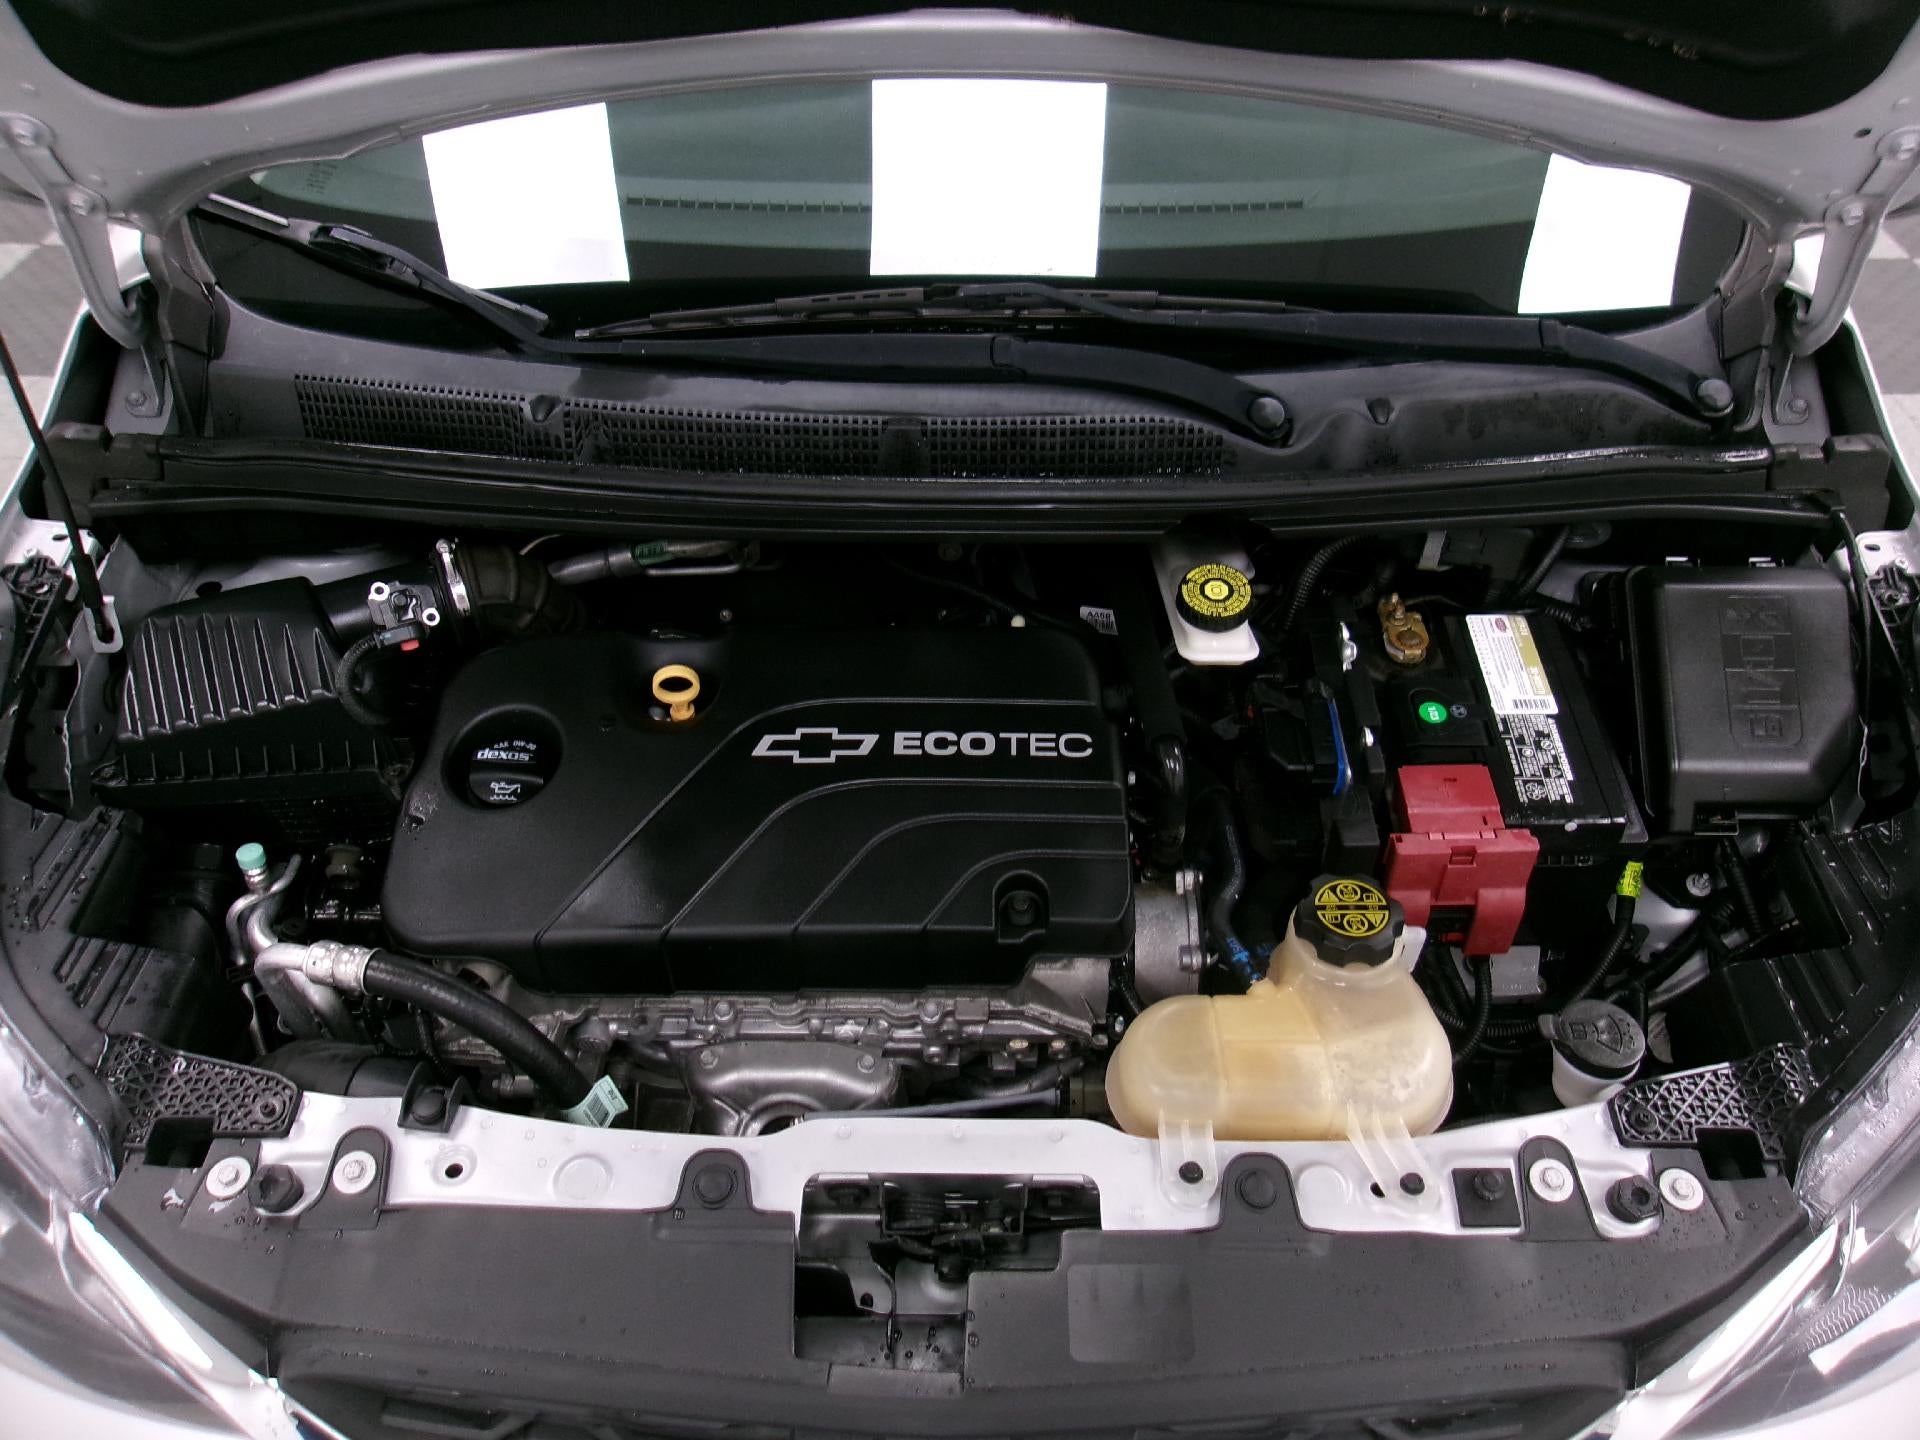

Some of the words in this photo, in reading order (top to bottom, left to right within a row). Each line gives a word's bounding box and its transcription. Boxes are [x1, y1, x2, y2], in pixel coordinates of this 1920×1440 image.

[477, 748, 530, 761] dexos
[893, 731, 1093, 757] ECOTEC
[1549, 722, 1565, 754] DANGER
[1559, 752, 1574, 780] POISON
